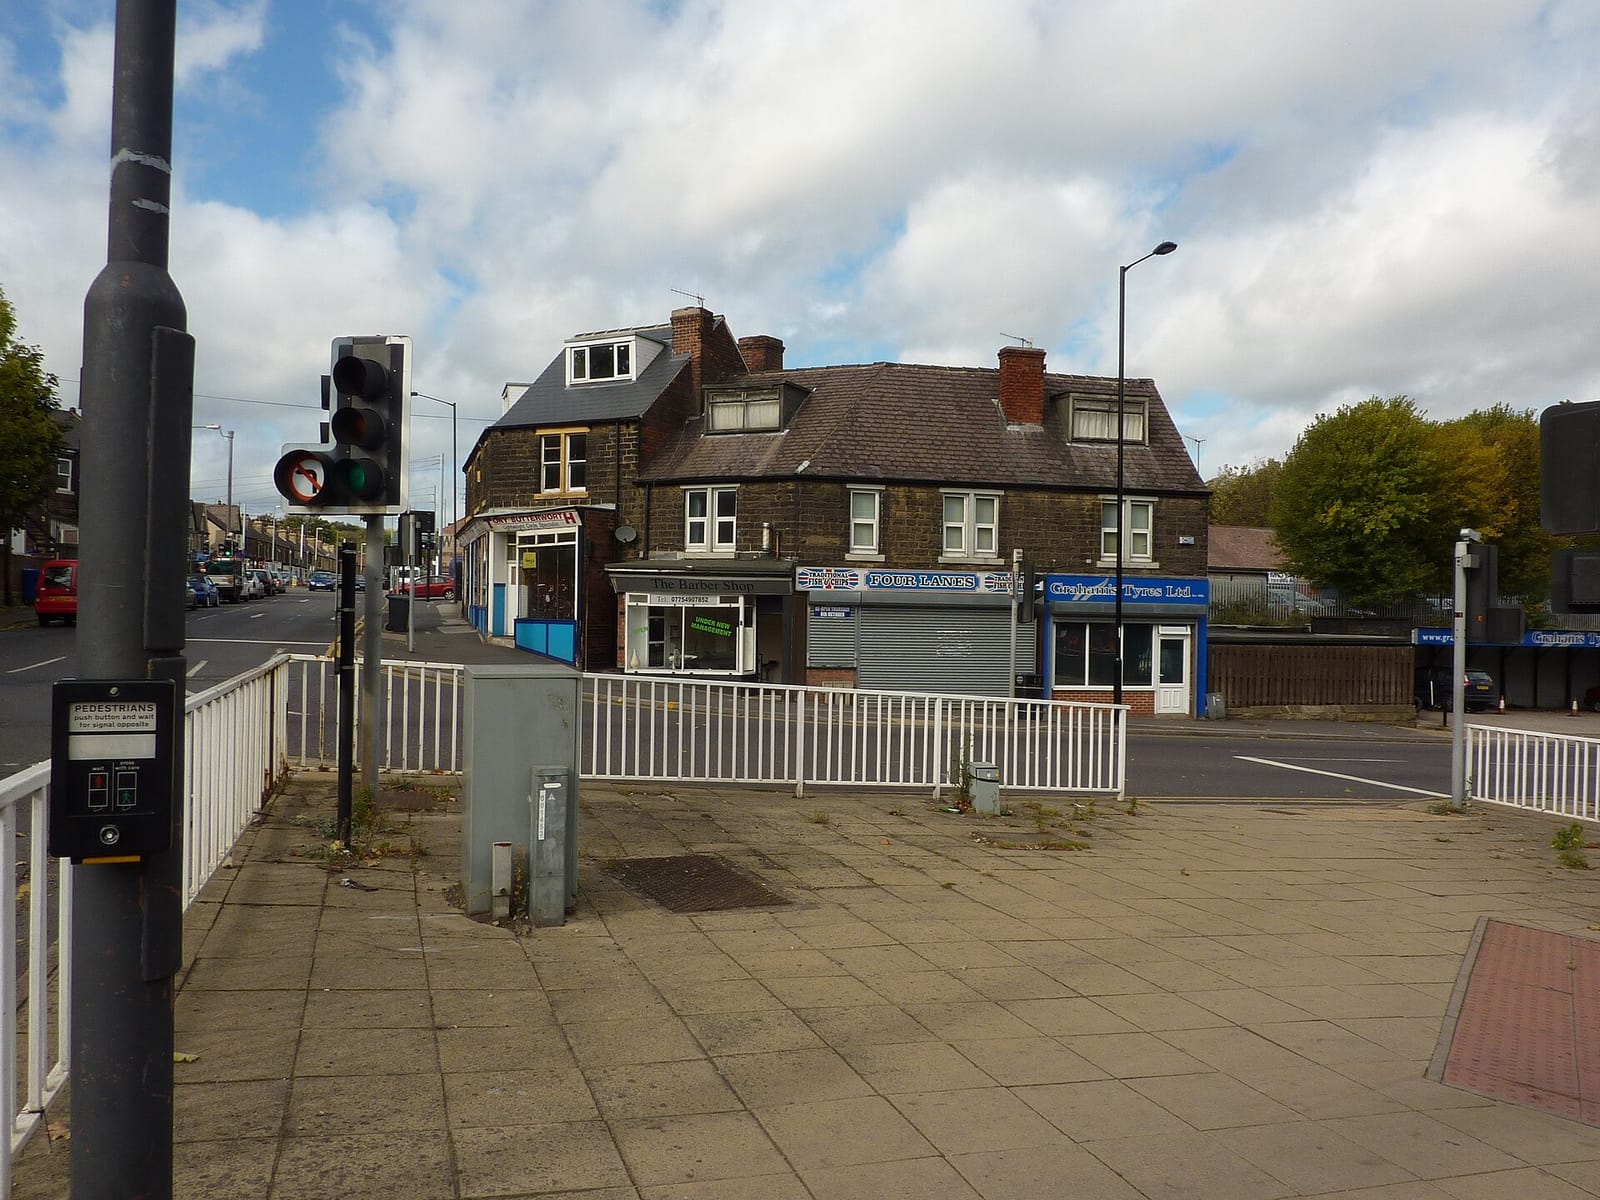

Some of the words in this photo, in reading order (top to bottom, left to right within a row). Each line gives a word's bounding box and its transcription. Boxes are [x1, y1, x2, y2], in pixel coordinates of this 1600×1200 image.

[511, 512, 577, 524] BUTTERWORTH
[652, 579, 676, 589] The
[679, 579, 720, 590] Barber
[723, 579, 754, 592] Shop
[831, 578, 849, 586] CHIPS
[870, 574, 916, 586] FOUR
[919, 575, 975, 588] LANES
[1122, 584, 1162, 599] Tyres
[1165, 585, 1191, 598] Ltd
[691, 622, 732, 637] MANAGEMENT
[695, 616, 717, 626] UNDER
[717, 621, 731, 630] NEW
[75, 704, 154, 713] PEDESTRIANS
[93, 721, 115, 729] signal
